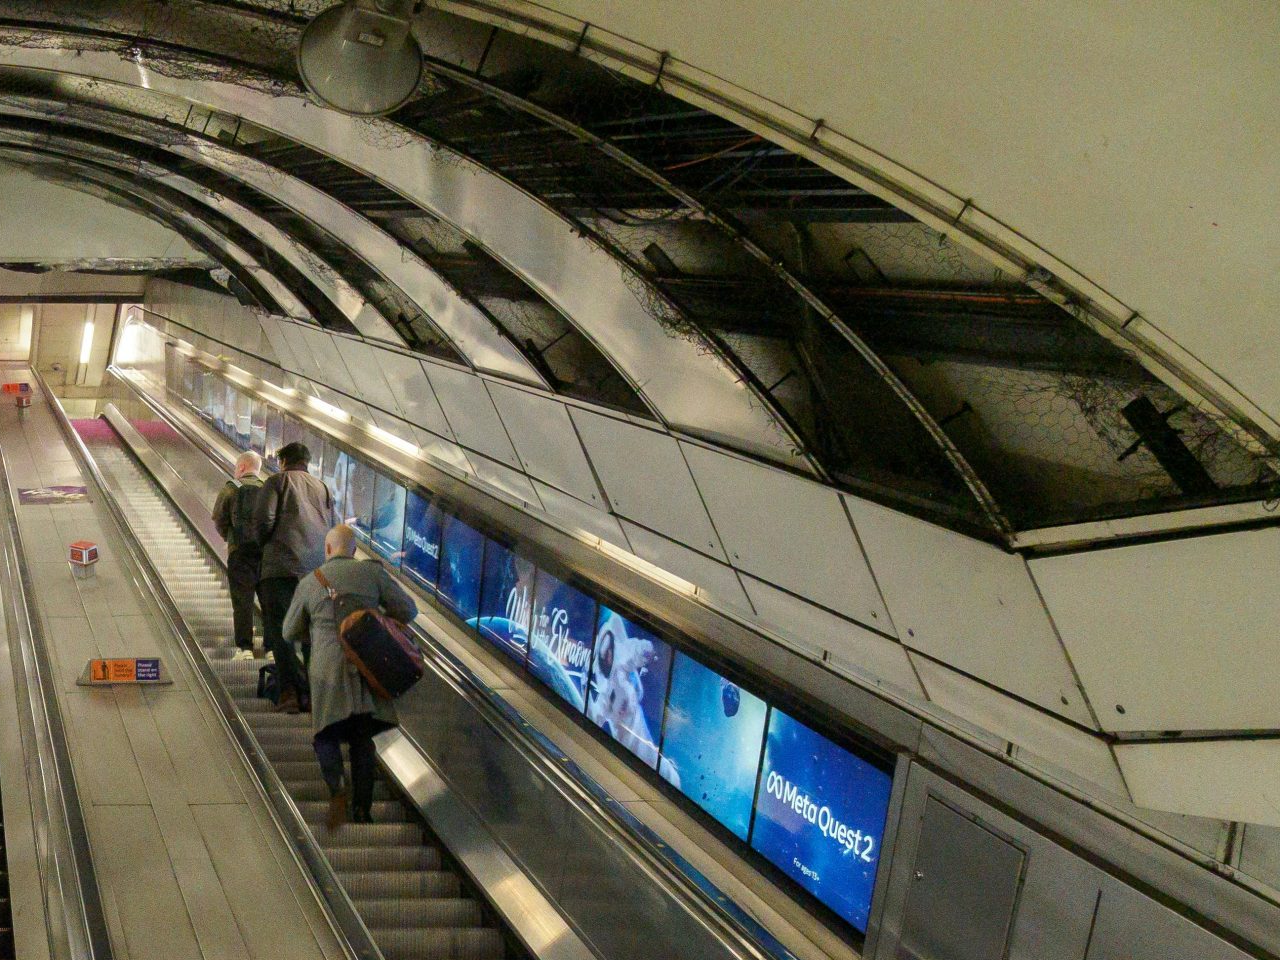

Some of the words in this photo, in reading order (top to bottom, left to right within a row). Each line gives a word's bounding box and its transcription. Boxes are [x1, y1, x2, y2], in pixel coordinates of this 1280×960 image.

[782, 780, 818, 825] Meta
[818, 806, 862, 856] Quest
[860, 835, 873, 863] 2
[793, 856, 801, 869] For
[800, 864, 811, 877] ages
